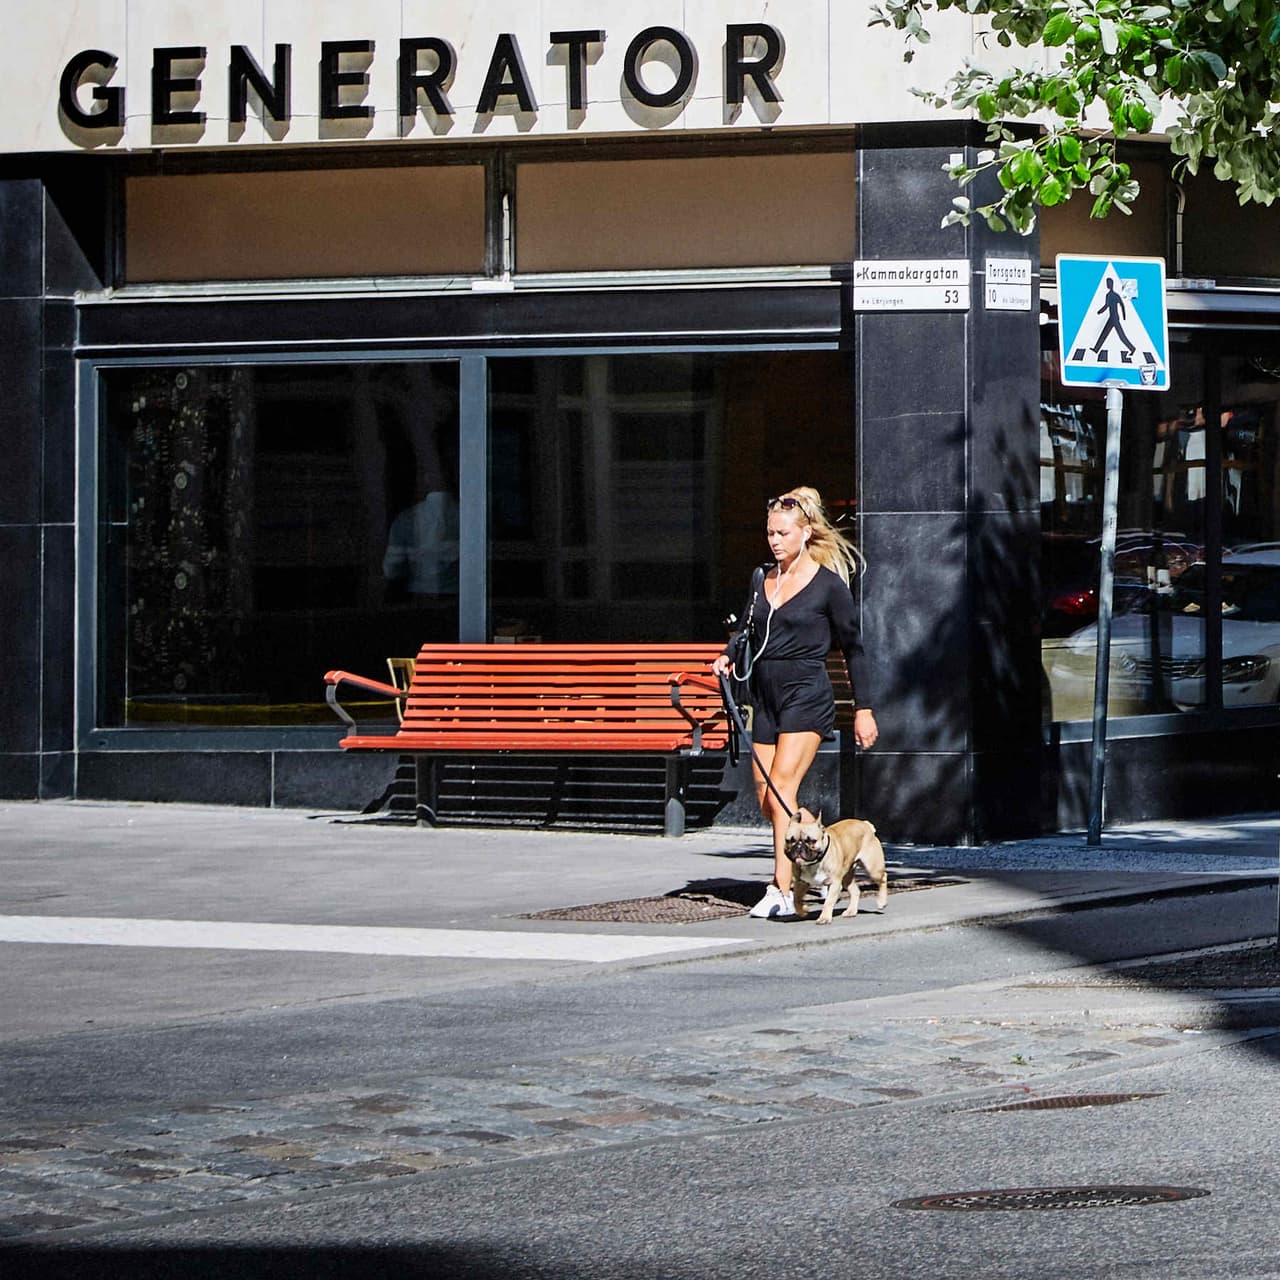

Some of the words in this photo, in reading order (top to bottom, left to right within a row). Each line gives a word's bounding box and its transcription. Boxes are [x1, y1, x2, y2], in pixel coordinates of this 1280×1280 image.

[58, 23, 785, 130] GENERATOR
[862, 266, 959, 284] Kammakargatan
[943, 289, 959, 304] 53
[988, 289, 997, 303] 10
